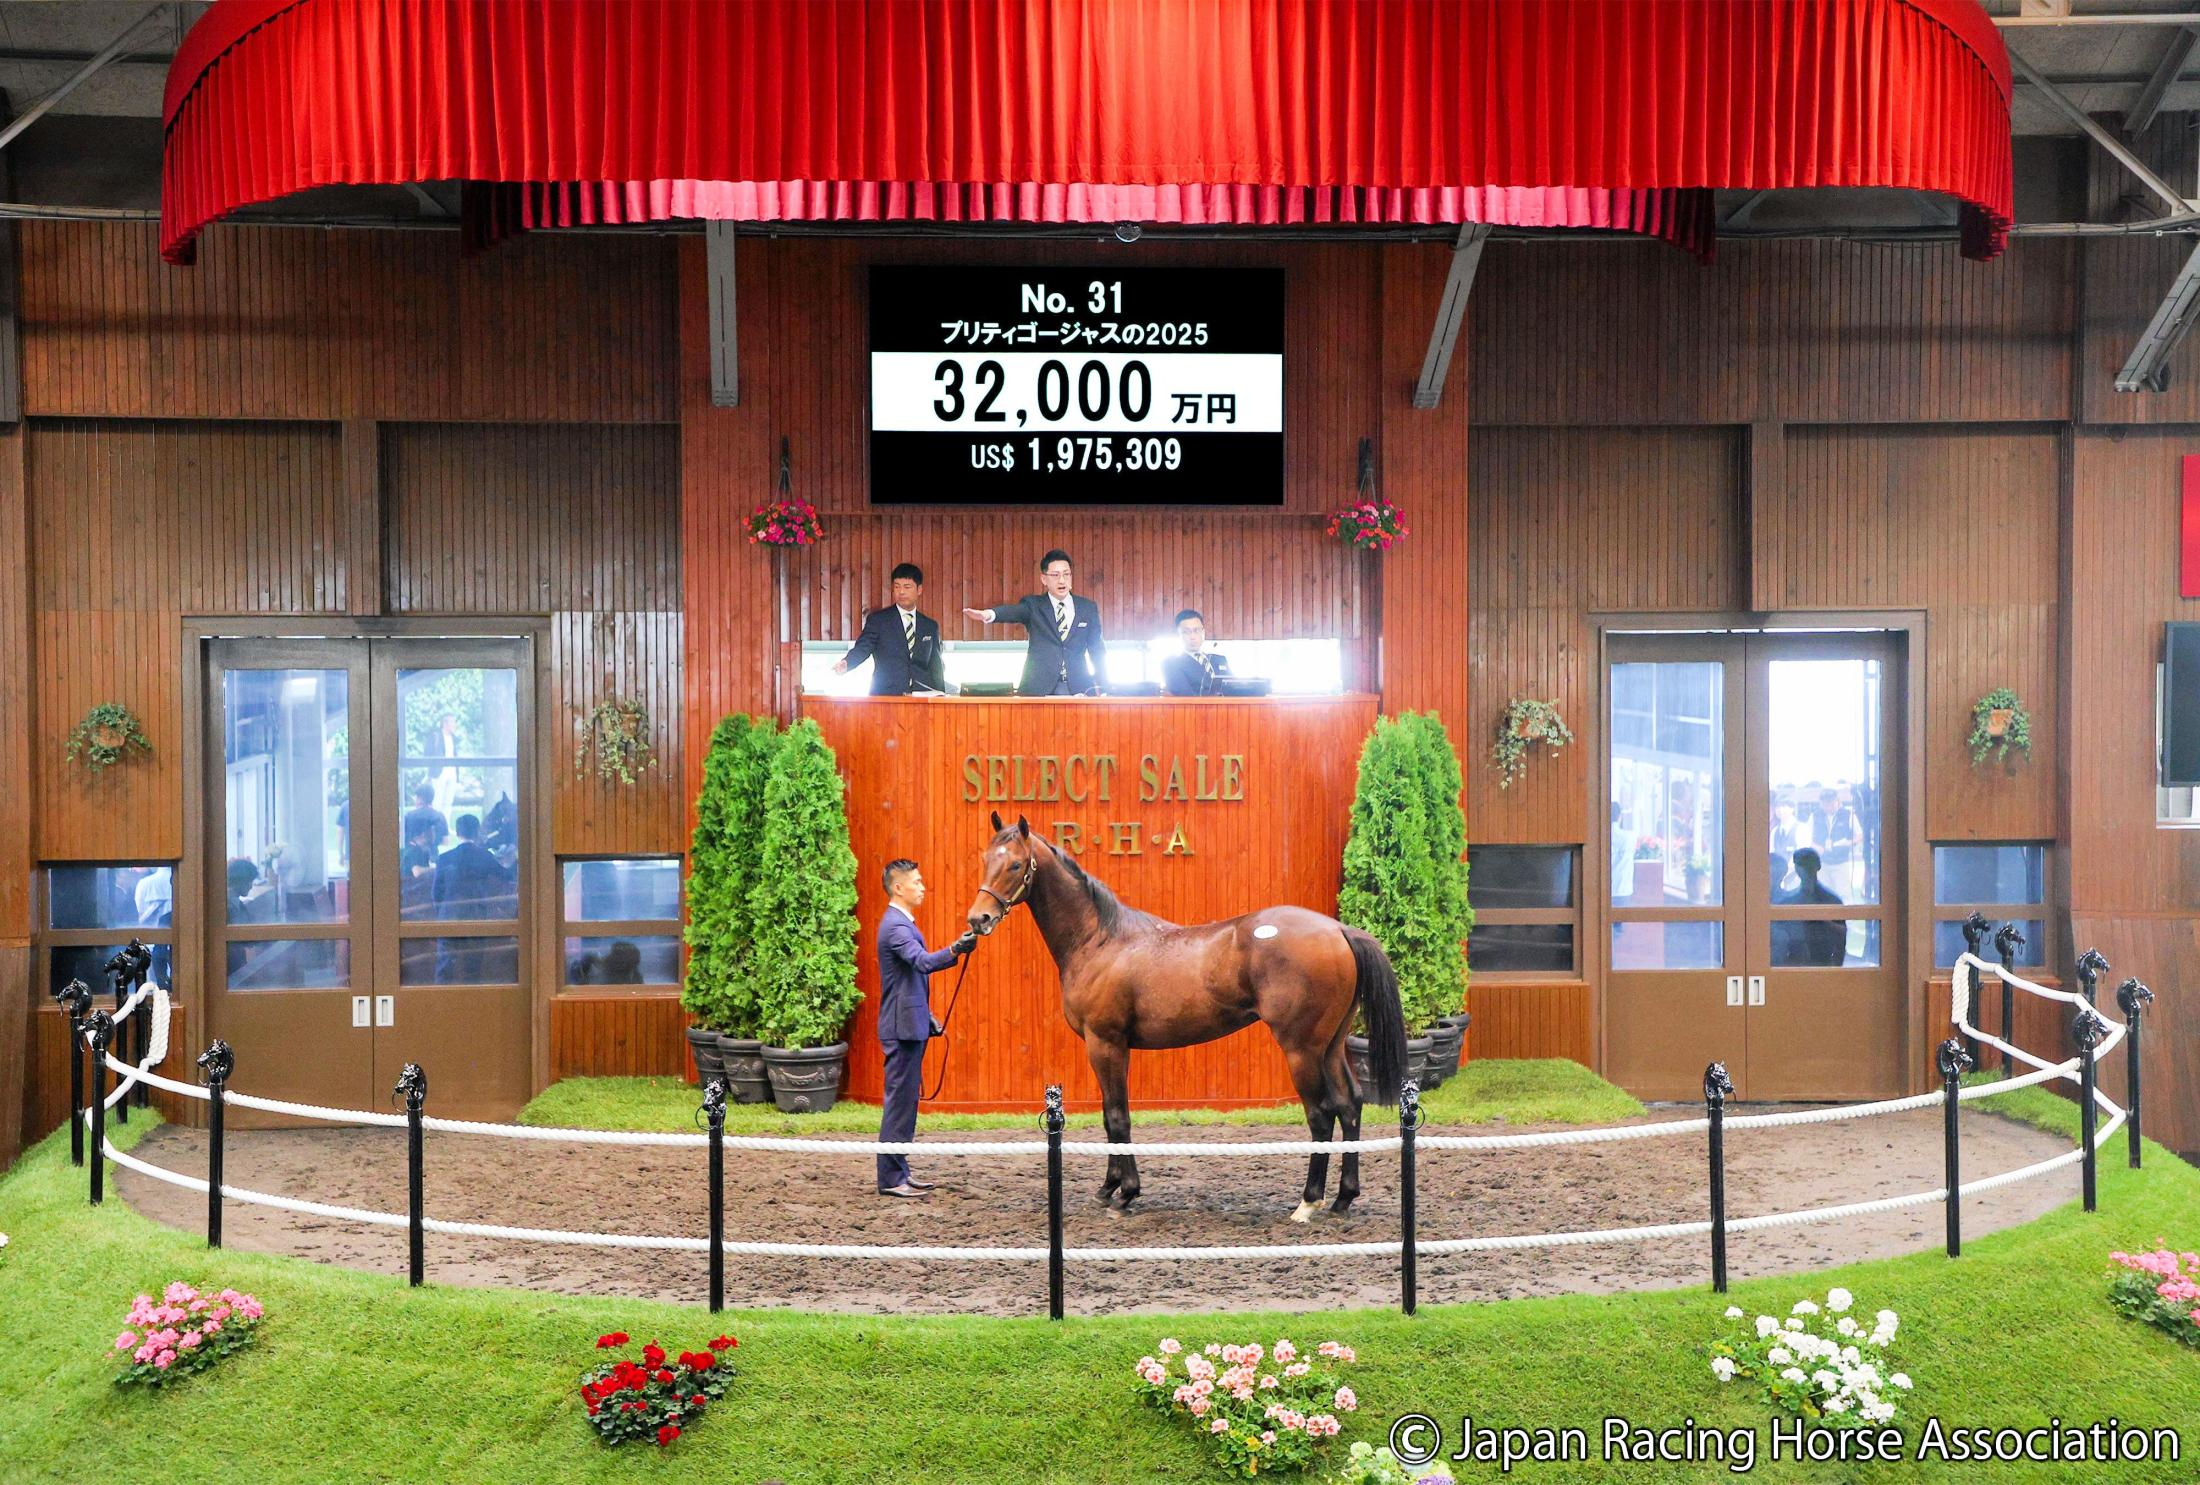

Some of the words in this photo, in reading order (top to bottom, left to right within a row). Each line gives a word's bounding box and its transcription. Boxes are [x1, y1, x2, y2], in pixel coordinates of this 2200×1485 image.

[1022, 284, 1074, 313] No.
[1088, 281, 1122, 313] 31
[940, 320, 1209, 345] プリティゴージャスの2025
[933, 359, 1152, 428] 32,000
[1171, 393, 1236, 424] 万円
[971, 442, 1015, 472] US$
[1028, 437, 1182, 473] 1,975,309
[962, 753, 1118, 803] SELECT
[1138, 753, 1245, 802] SALE
